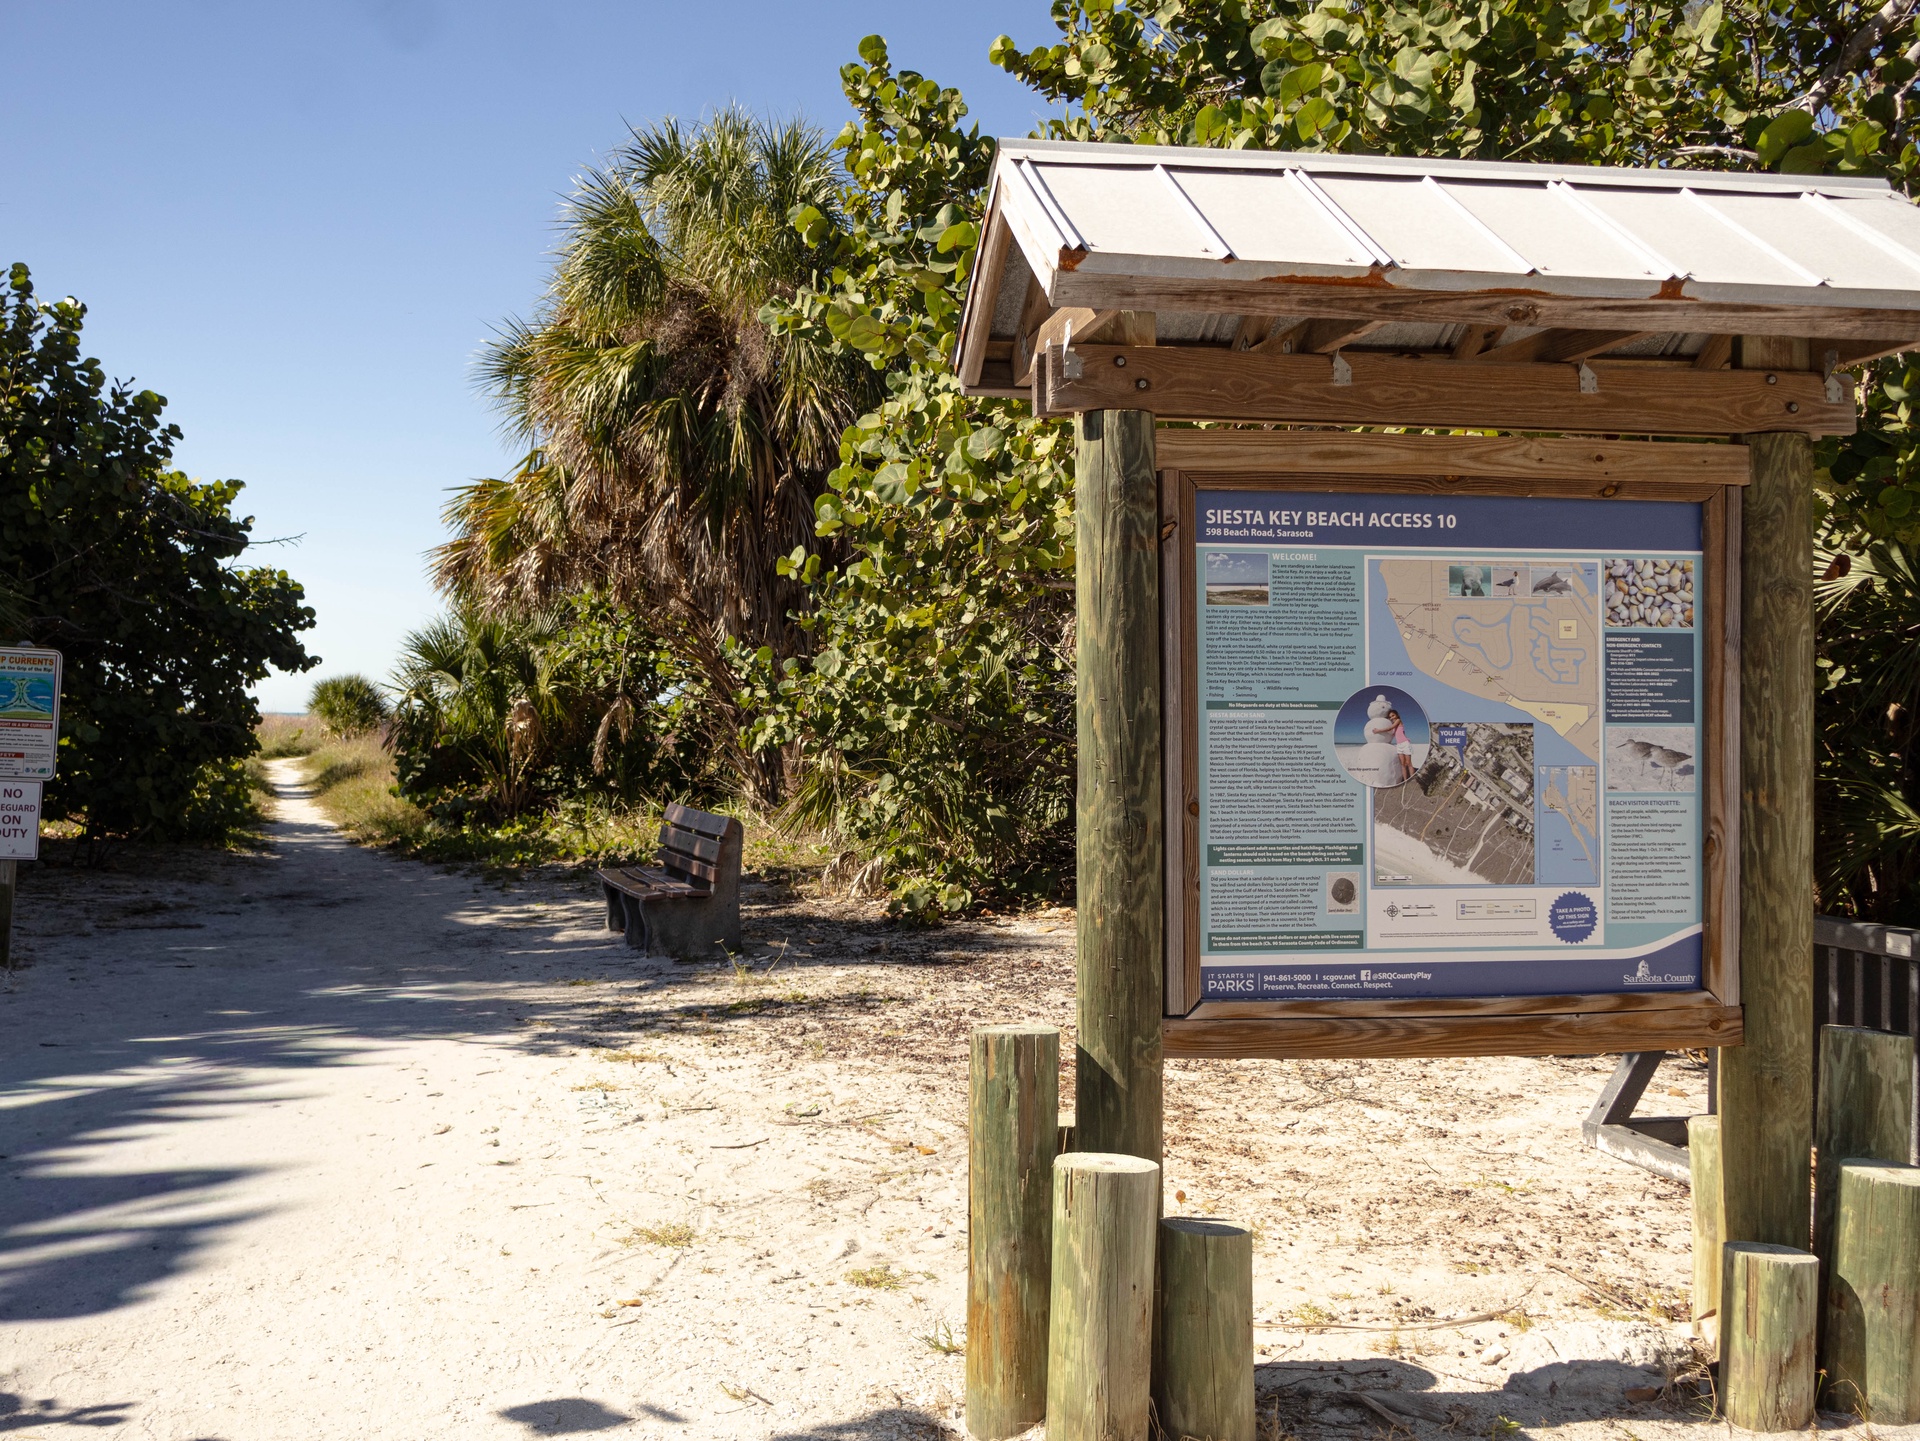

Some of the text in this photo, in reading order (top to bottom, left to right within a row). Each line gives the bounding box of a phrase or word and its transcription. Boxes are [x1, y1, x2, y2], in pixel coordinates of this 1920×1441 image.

[1206, 510, 1456, 528] SIESTA KEY BEACH ACCESS 10
[1224, 528, 1249, 536] Beach
[1277, 529, 1313, 538] Sarasota
[9, 657, 54, 665] CURRENTS
[4, 789, 22, 798] NO
[1, 804, 35, 812] EGUARD
[2, 815, 21, 824] ON
[0, 828, 27, 838] UTY
[1263, 974, 1311, 982] 941-861-5000
[1372, 972, 1432, 981] @SRQCountyPlay
[1664, 974, 1696, 982] County
[1208, 980, 1254, 992] PARKS
